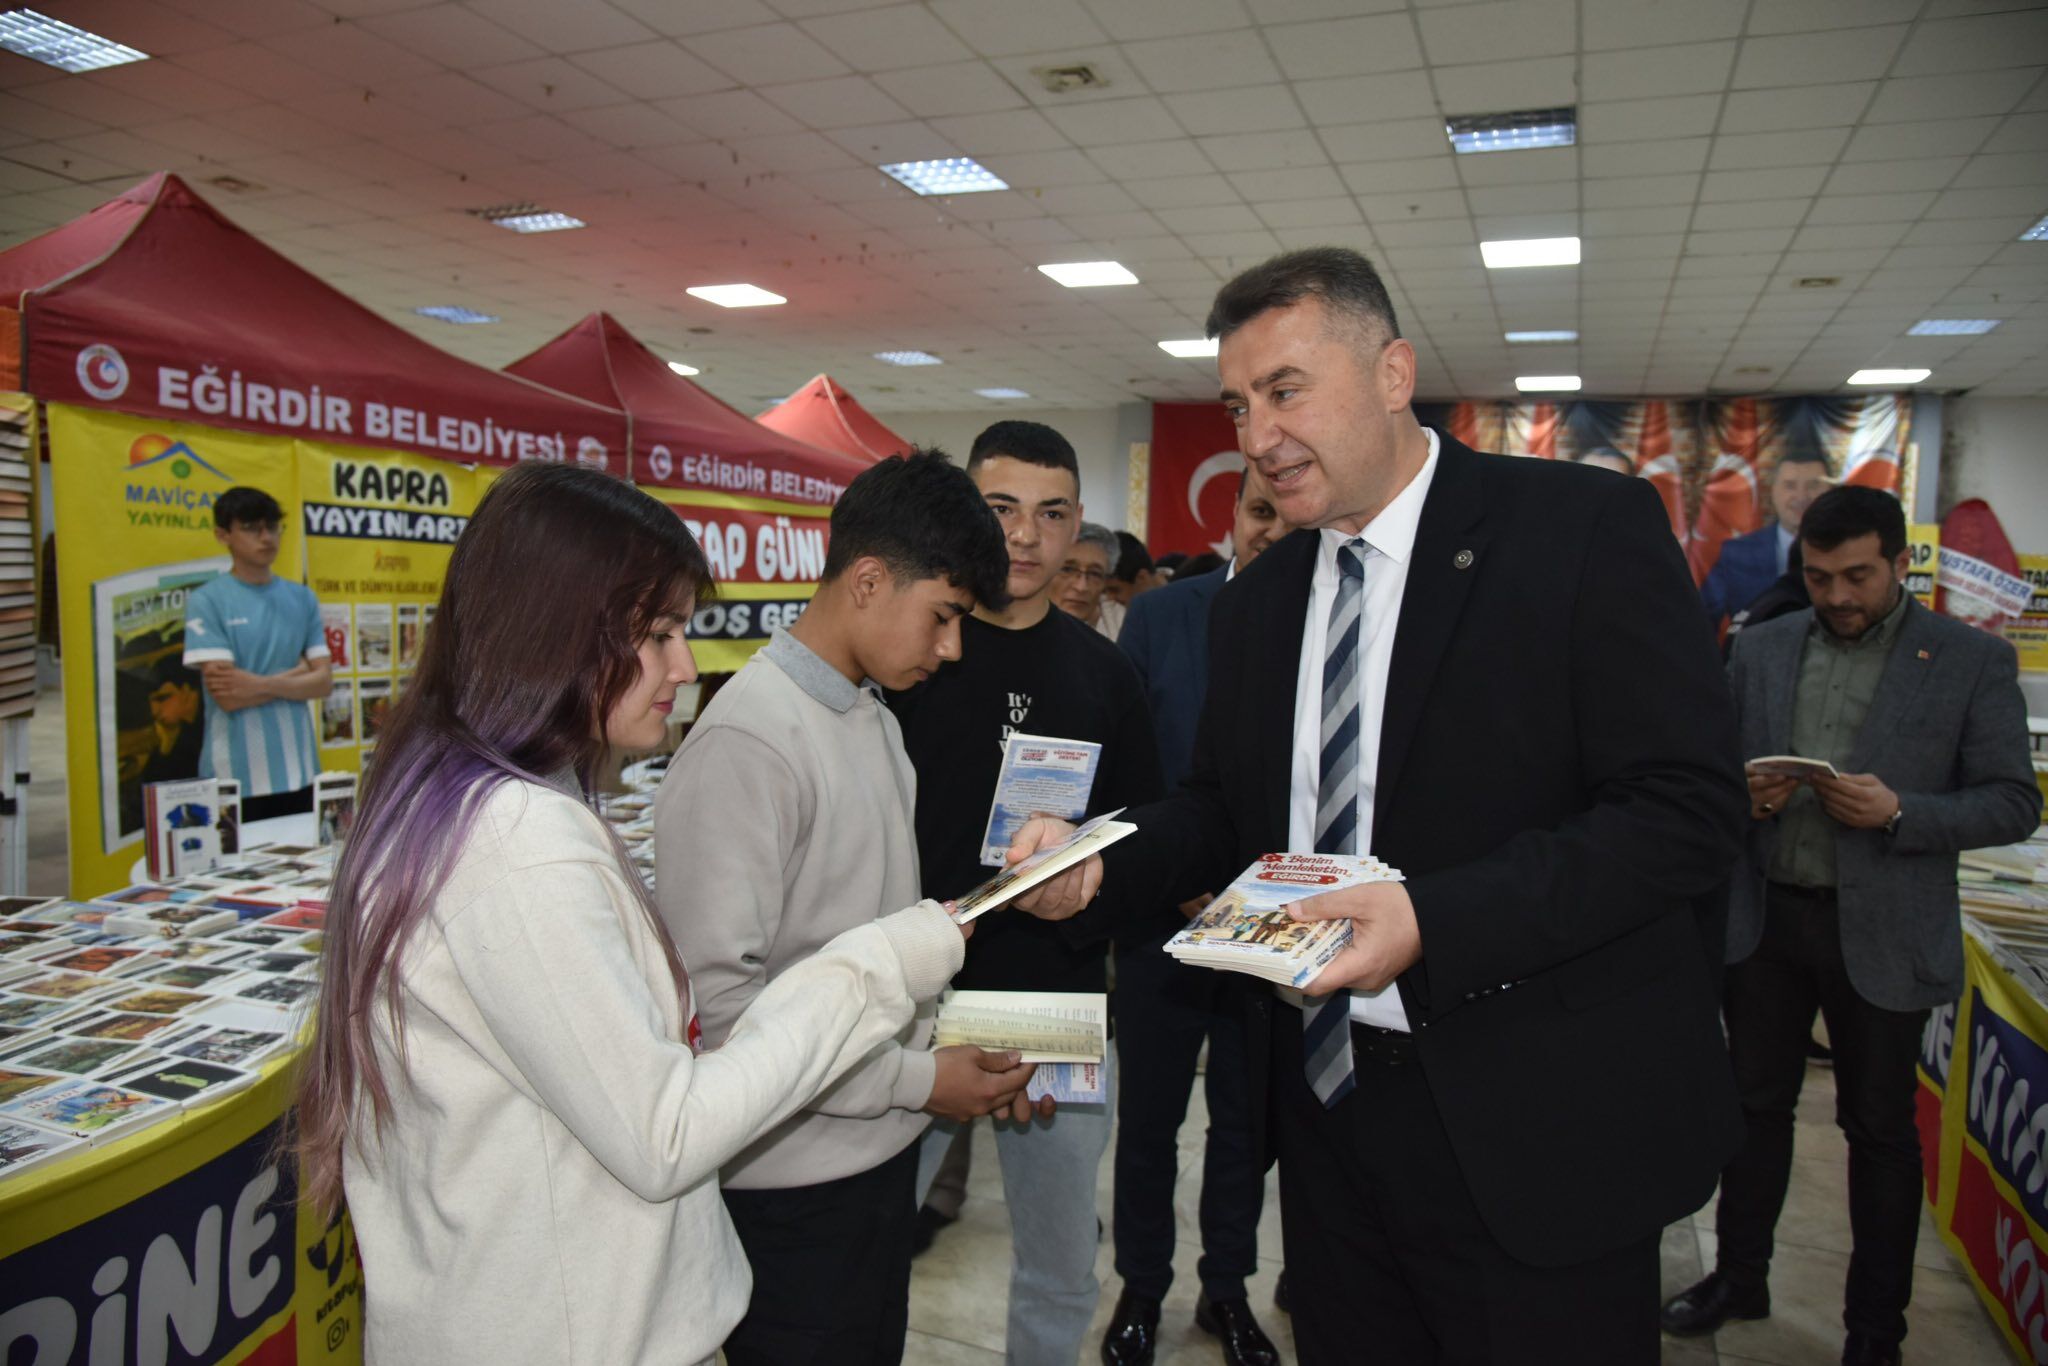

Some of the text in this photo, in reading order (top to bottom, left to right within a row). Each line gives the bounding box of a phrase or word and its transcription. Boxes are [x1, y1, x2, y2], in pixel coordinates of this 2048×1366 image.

[158, 364, 565, 462] EĞİRDİR BELEDİYESİ
[334, 462, 448, 507] KAPRA
[682, 453, 848, 504] EĞİRDİR BELEDİY
[127, 510, 216, 531] YAYINLA
[684, 603, 808, 639] OŞ GE
[1262, 863, 1349, 876] Memleketim
[1289, 855, 1333, 866] Benim
